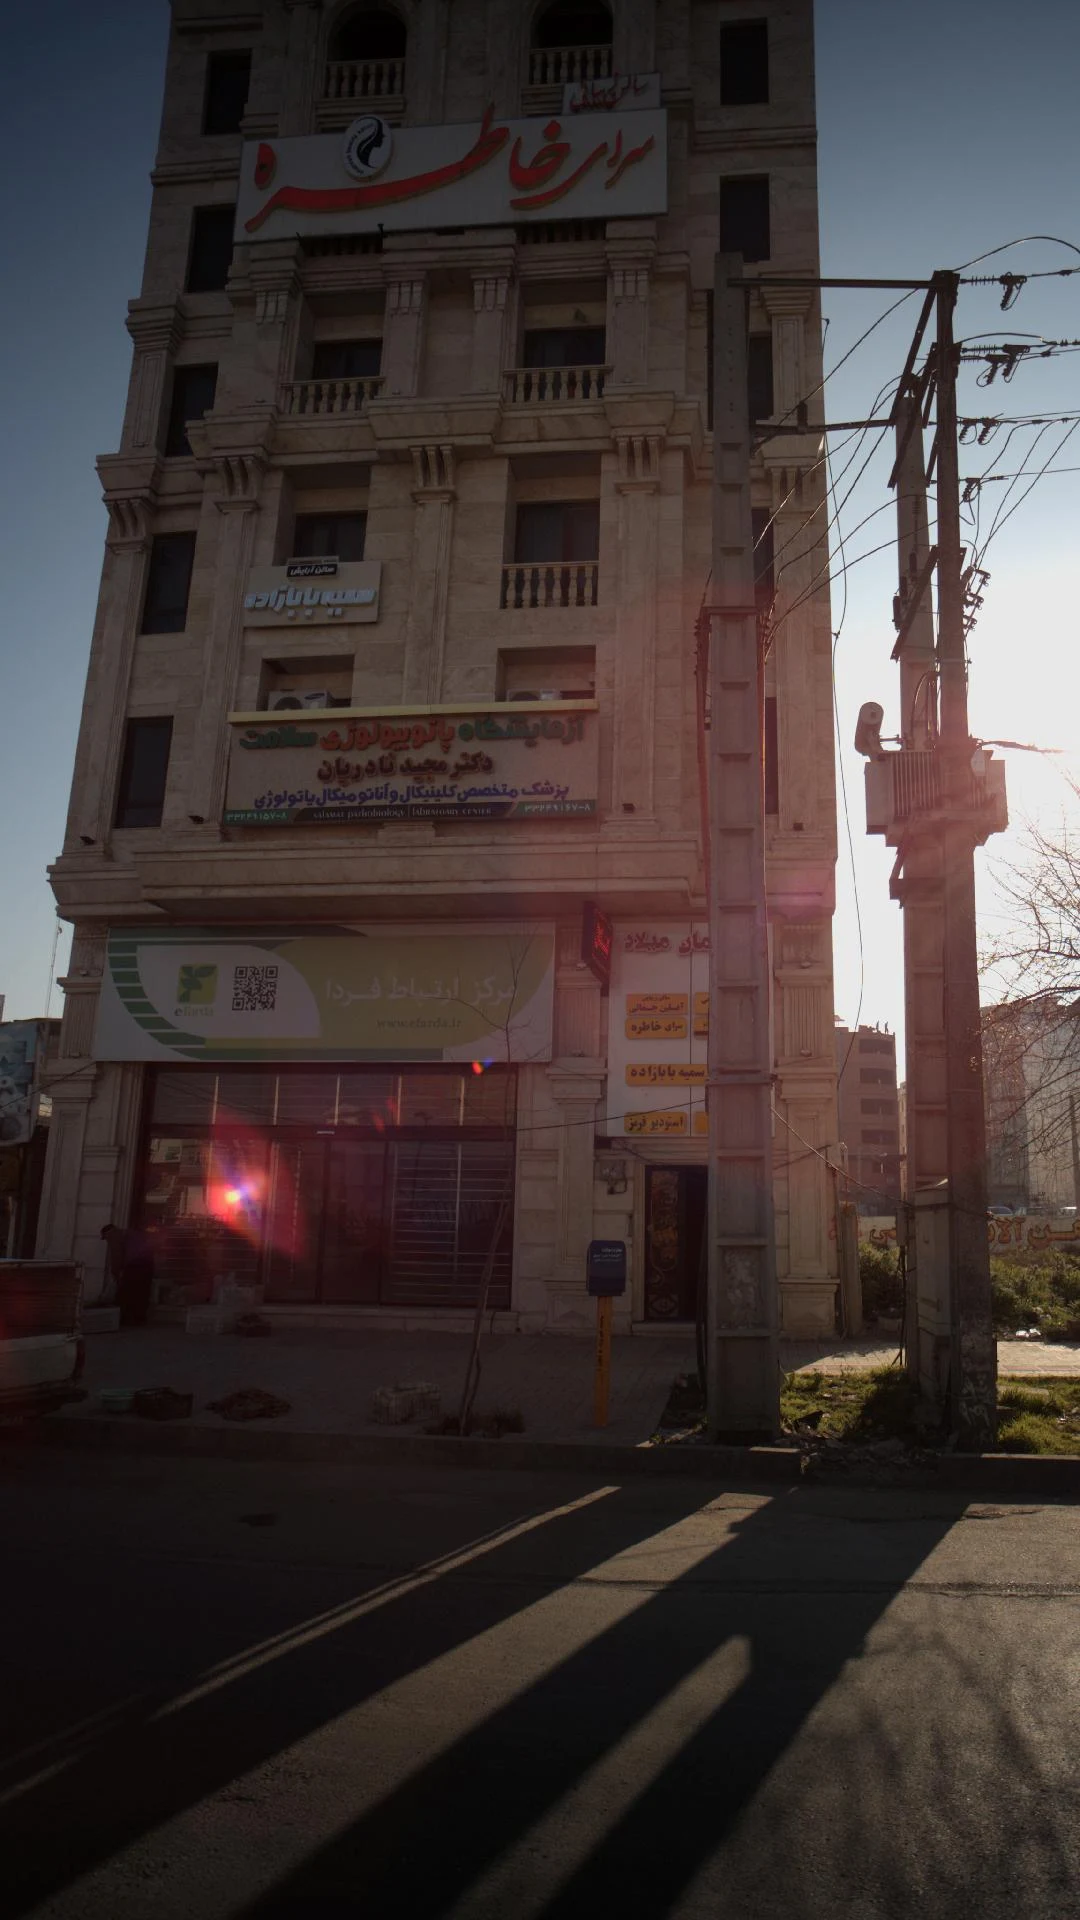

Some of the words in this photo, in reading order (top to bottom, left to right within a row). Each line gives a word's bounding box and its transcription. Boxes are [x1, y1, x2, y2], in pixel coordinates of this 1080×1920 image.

[244, 103, 571, 233] خاطره
[510, 129, 655, 211] سرای
[240, 724, 318, 749] سلامت
[458, 713, 586, 748] آزمایشگاه
[399, 756, 448, 783] مجید
[449, 751, 494, 780] دکتر
[400, 783, 457, 804] کلینیکال
[457, 782, 519, 802] متخصص
[521, 780, 570, 801] پزشک
[325, 974, 382, 1008] فردا
[388, 974, 460, 1008] ارتباط
[471, 974, 515, 1006] مرکز
[174, 1006, 214, 1017] efarda
[376, 1016, 462, 1030] www.efarda.ir
[631, 1020, 662, 1034] خاطره
